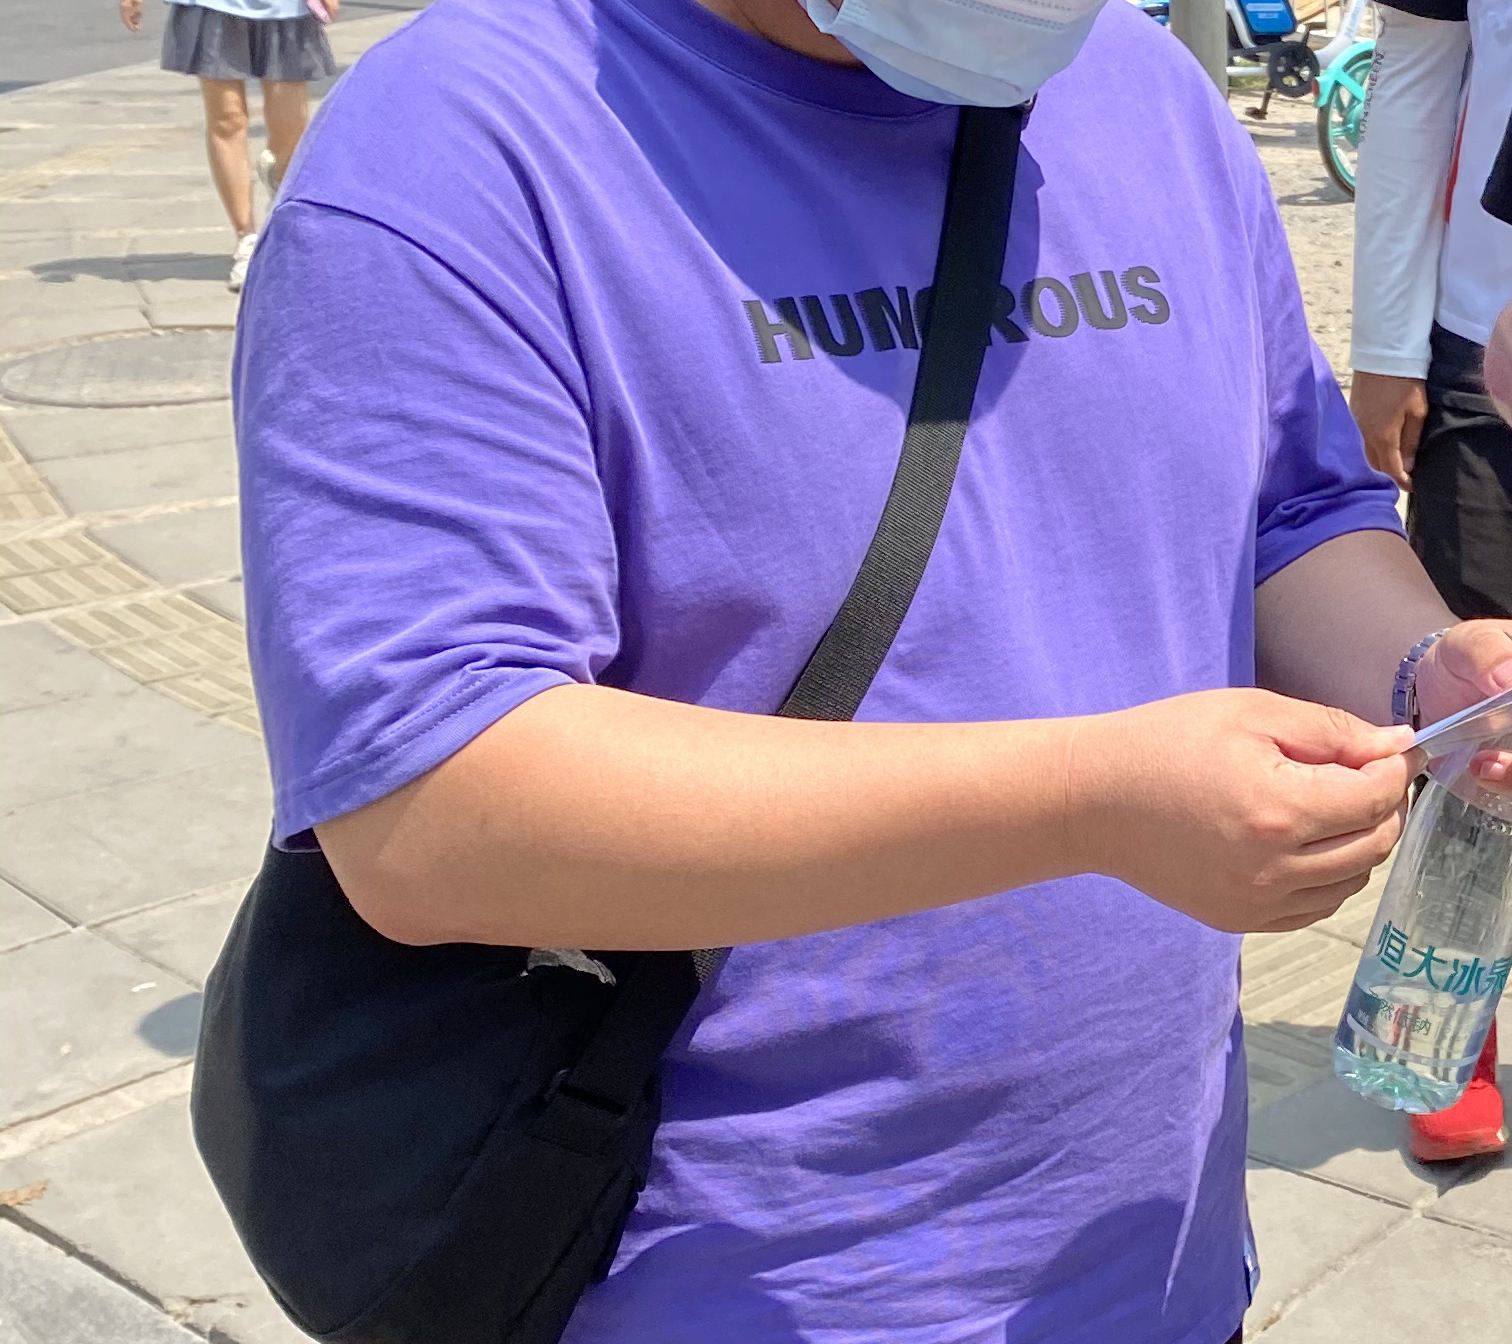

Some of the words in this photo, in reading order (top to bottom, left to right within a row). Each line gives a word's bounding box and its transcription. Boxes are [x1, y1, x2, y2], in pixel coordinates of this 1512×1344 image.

[741, 265, 1170, 364] HUNROUS
[1376, 920, 1512, 995] 恒大冰泉
